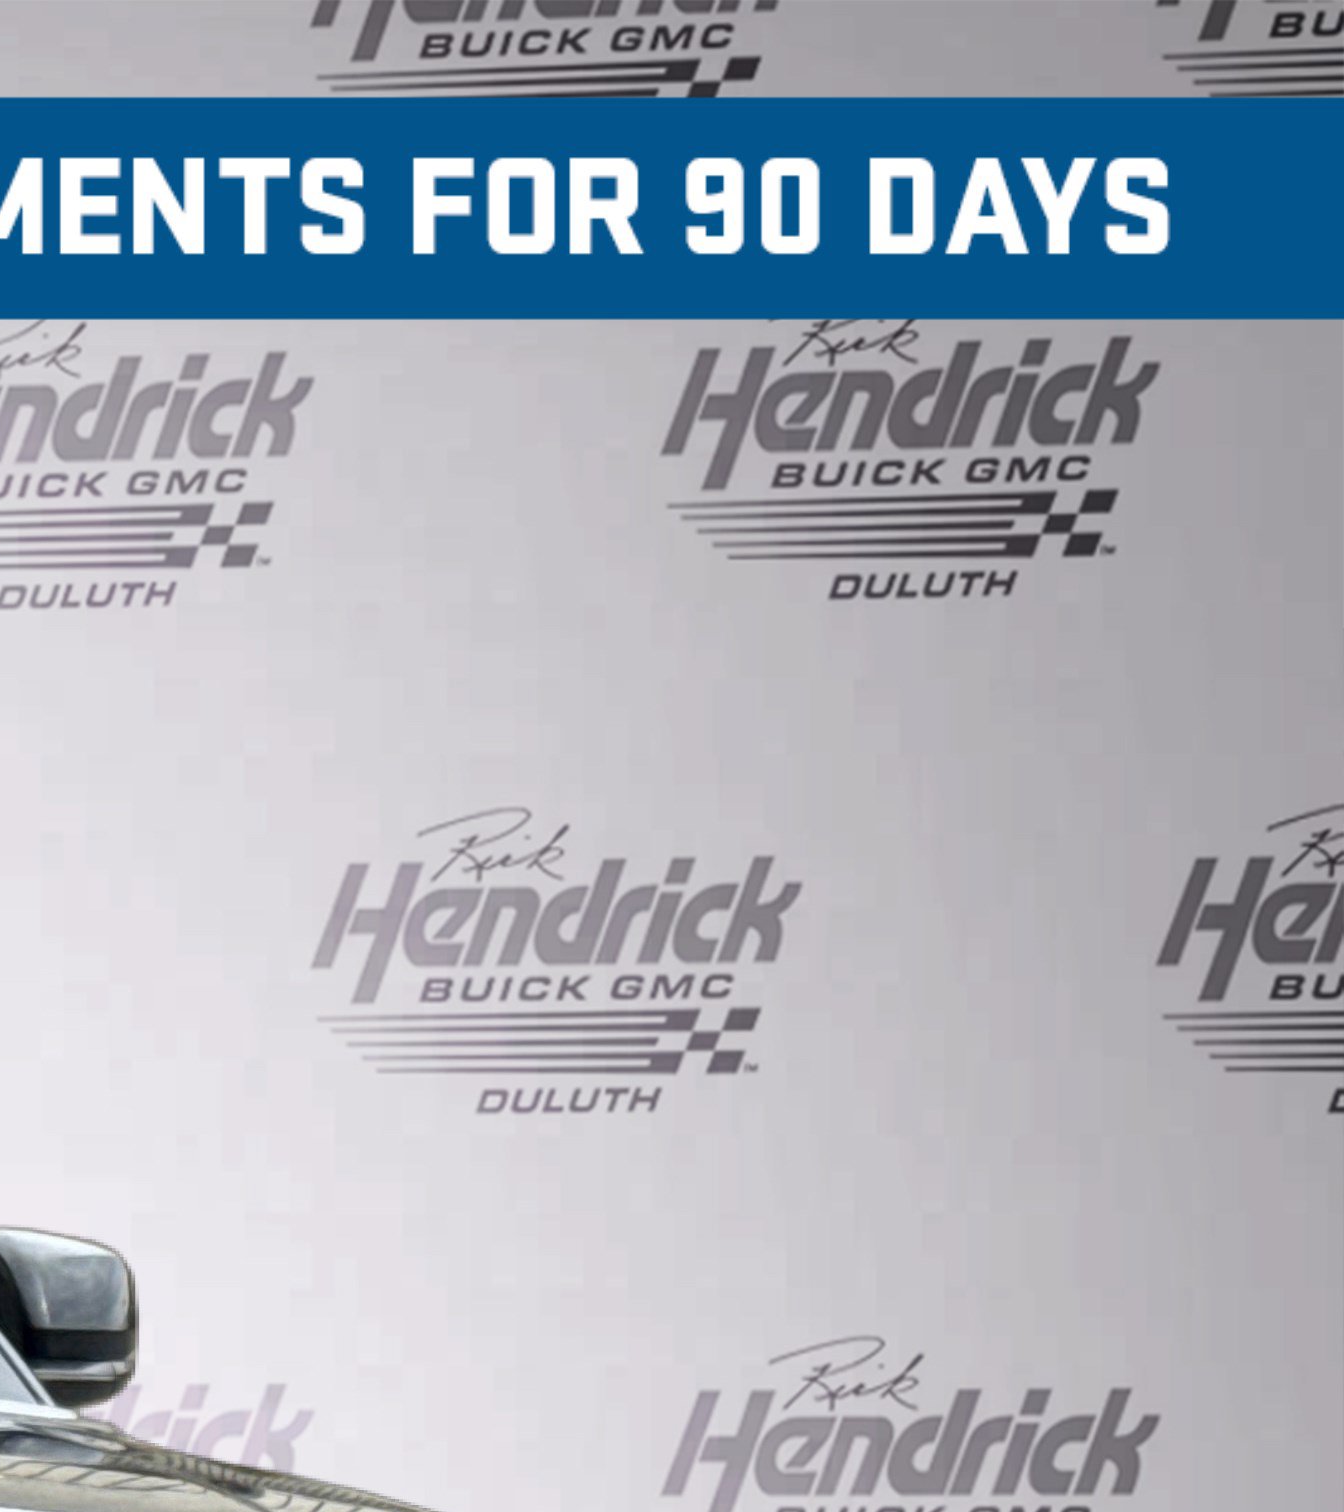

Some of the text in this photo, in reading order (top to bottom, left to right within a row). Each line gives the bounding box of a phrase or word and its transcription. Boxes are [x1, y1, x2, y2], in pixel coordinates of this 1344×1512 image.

[418, 27, 595, 60] BUICK
[611, 23, 734, 52] GMC
[660, 336, 1161, 491] Hendrick
[125, 468, 248, 495] GMC
[770, 455, 1092, 489] BUICK GMC
[827, 570, 1018, 600] DULUTH
[310, 856, 803, 1004] Hendrick
[419, 974, 735, 1002] BUICK GMC
[476, 1088, 662, 1114] DULUTH
